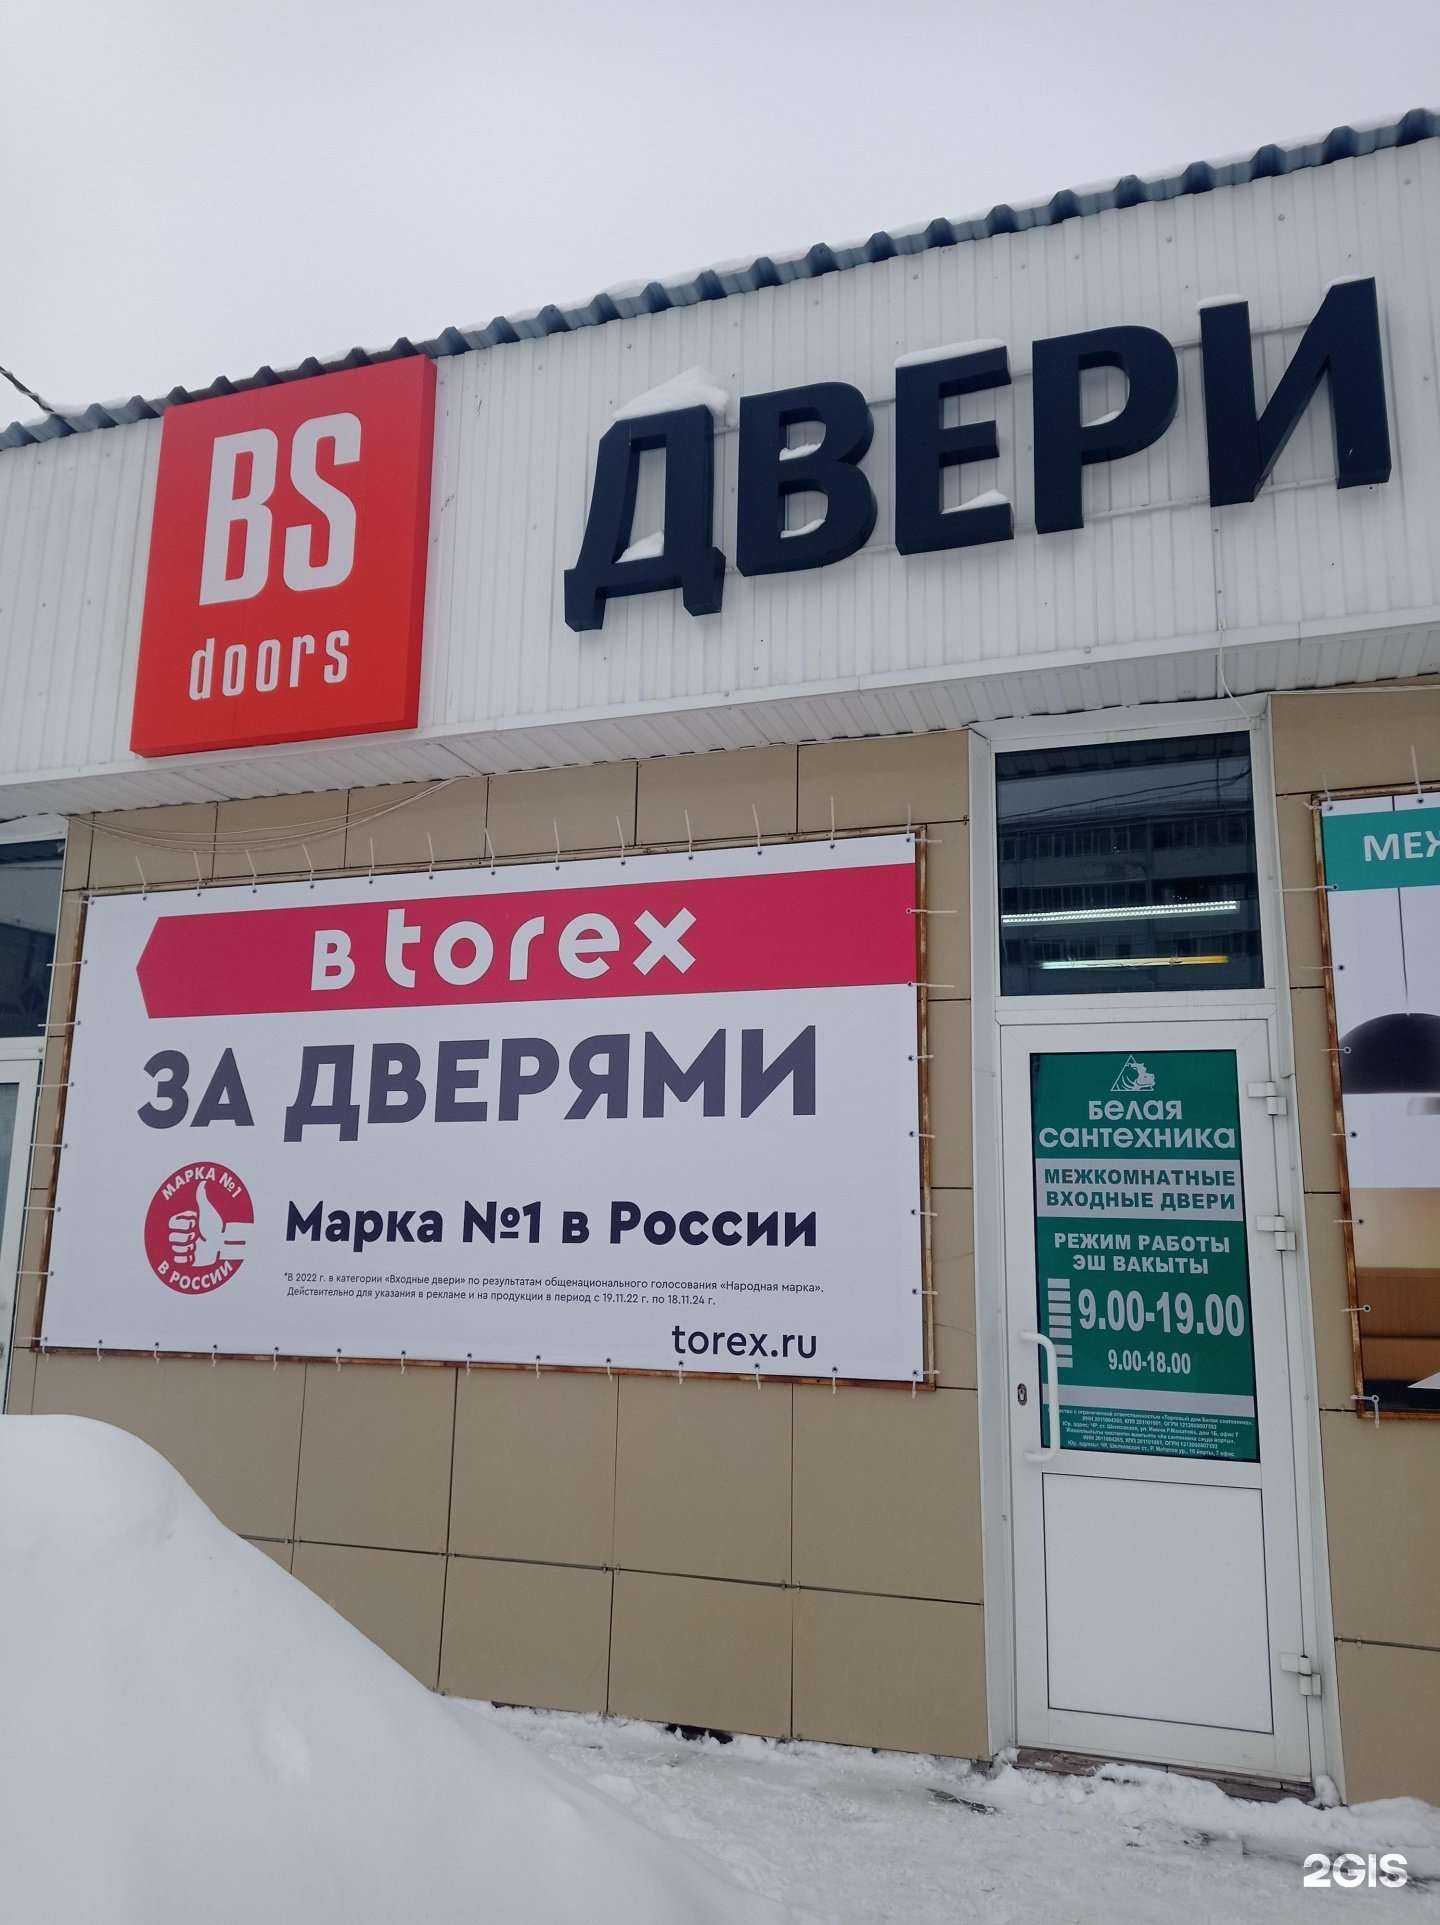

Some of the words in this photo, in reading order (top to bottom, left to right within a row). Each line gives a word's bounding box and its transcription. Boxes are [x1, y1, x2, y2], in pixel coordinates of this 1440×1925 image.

[564, 276, 1392, 631] ДВЕРИ
[199, 412, 362, 606] BS
[189, 629, 350, 701] doors
[384, 906, 697, 989] torex
[137, 1047, 255, 1129] ЗА
[284, 1025, 816, 1142] ДВЕРЯМИ
[162, 1166, 216, 1200] МАРКА
[218, 1172, 242, 1199] №1
[1044, 1168, 1236, 1187] МЕЖКОМНАТНЫЕ
[1046, 1190, 1154, 1210] ВХОДНЫЕ
[1160, 1192, 1236, 1212] ДВЕРИ
[286, 1200, 443, 1252] Марка
[462, 1201, 541, 1243] №1
[561, 1210, 590, 1244] в
[609, 1201, 816, 1246] России
[1053, 1232, 1131, 1250] РЕЖИМ
[1137, 1234, 1230, 1253] РАБОТЫ
[158, 1259, 170, 1276] В
[169, 1260, 233, 1290] РОССИИ
[1072, 1254, 1106, 1271] ЭШ
[1112, 1255, 1209, 1275] ВАКЫТЫ
[286, 1286, 355, 1296] Действительно
[356, 1289, 372, 1298] для
[374, 1289, 416, 1299] указания
[426, 1290, 466, 1301] рекламе
[477, 1292, 488, 1300] на
[490, 1292, 543, 1303] продукции
[554, 1293, 592, 1304] период
[602, 1293, 639, 1304] 19.11.22
[652, 1296, 665, 1304] по
[667, 1294, 705, 1305] 18.11.24
[296, 1273, 317, 1283] 2022
[336, 1275, 382, 1286] категории
[384, 1274, 429, 1286] «Входные
[431, 1277, 465, 1287] двери»
[468, 1278, 480, 1286] по
[482, 1278, 542, 1288] результатам
[544, 1277, 648, 1289] общенационального
[651, 1280, 718, 1291] голосования
[720, 1281, 779, 1294] «Народная
[1078, 1288, 1245, 1337] 9.00-19.00
[672, 1325, 816, 1359] torex.ru
[1108, 1349, 1191, 1374] 9.00-18.00
